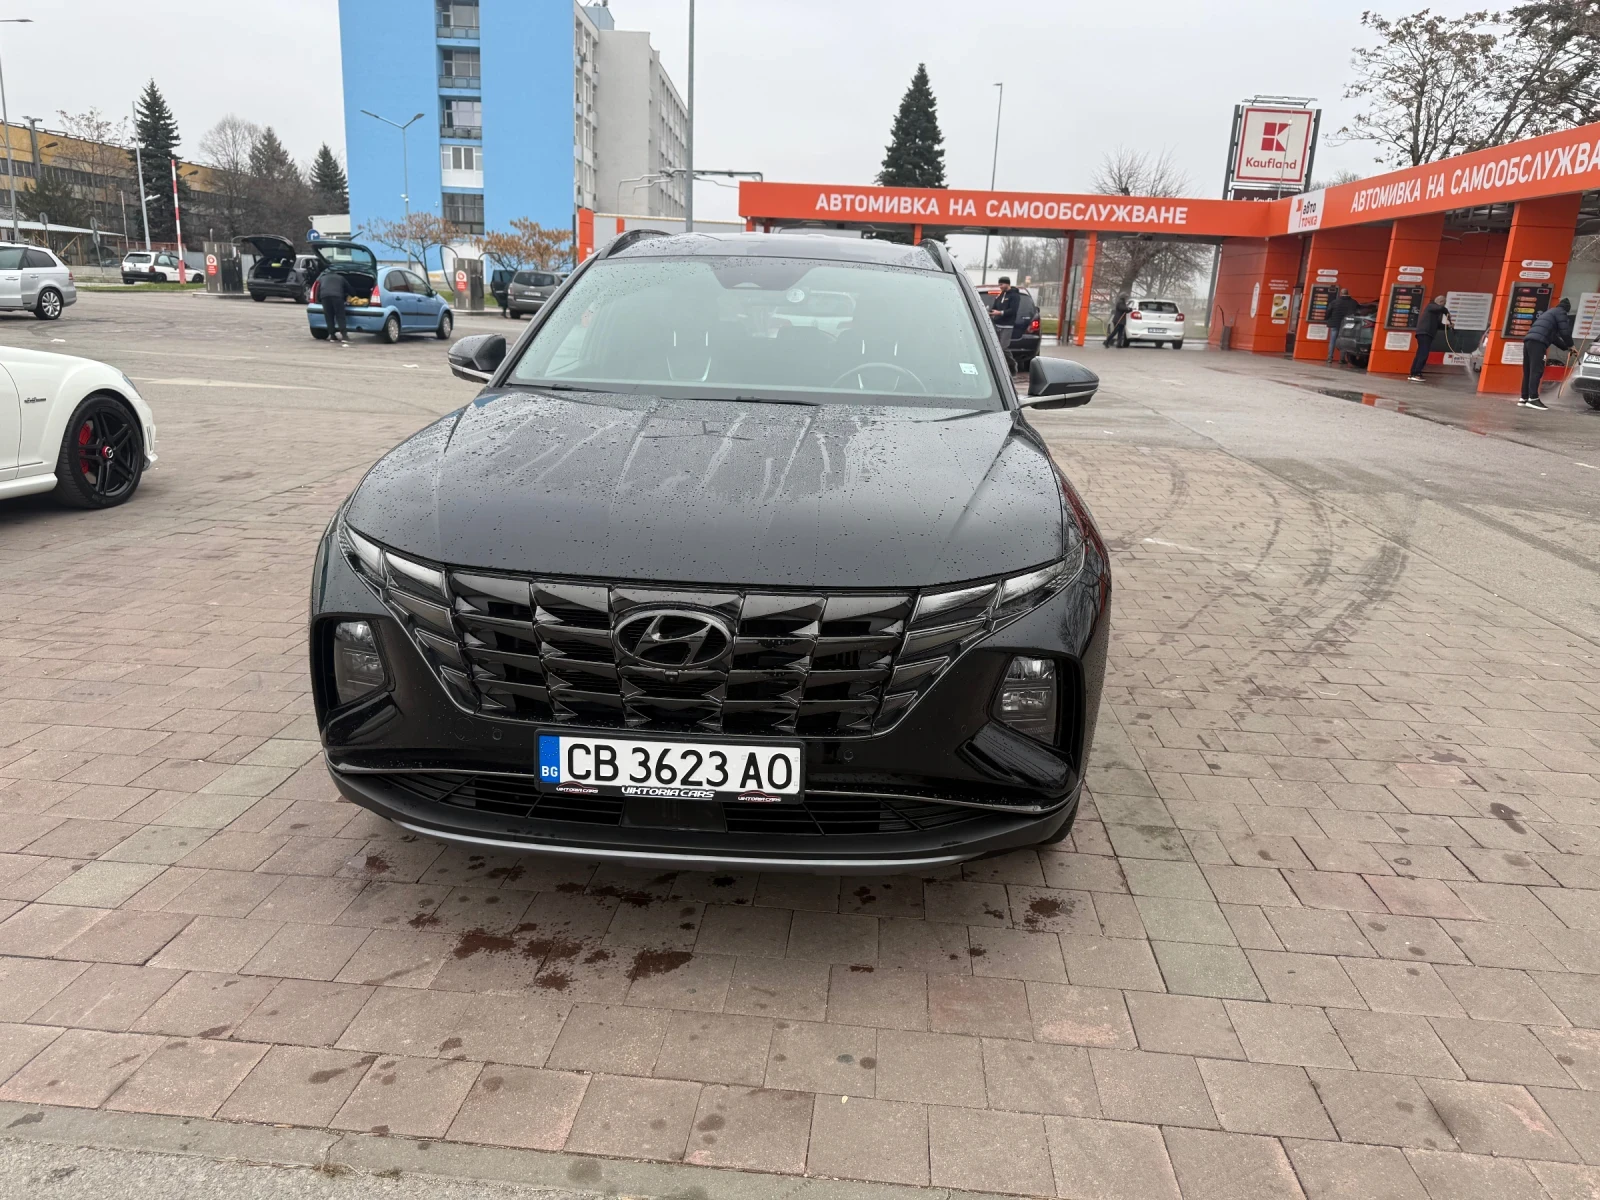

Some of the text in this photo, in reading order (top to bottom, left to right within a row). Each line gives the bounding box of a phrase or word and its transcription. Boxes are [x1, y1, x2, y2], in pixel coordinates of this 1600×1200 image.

[1245, 157, 1297, 169] Kaufland
[815, 192, 1188, 225] АВТОМИВКА НА САМООБСЛУЖВАНЕ
[1350, 178, 1422, 213] АВТОМИВКА
[1426, 173, 1445, 200] НА
[541, 766, 558, 778] BG
[567, 743, 619, 782] CB
[629, 747, 729, 787] 3623
[680, 789, 715, 798] CARS
